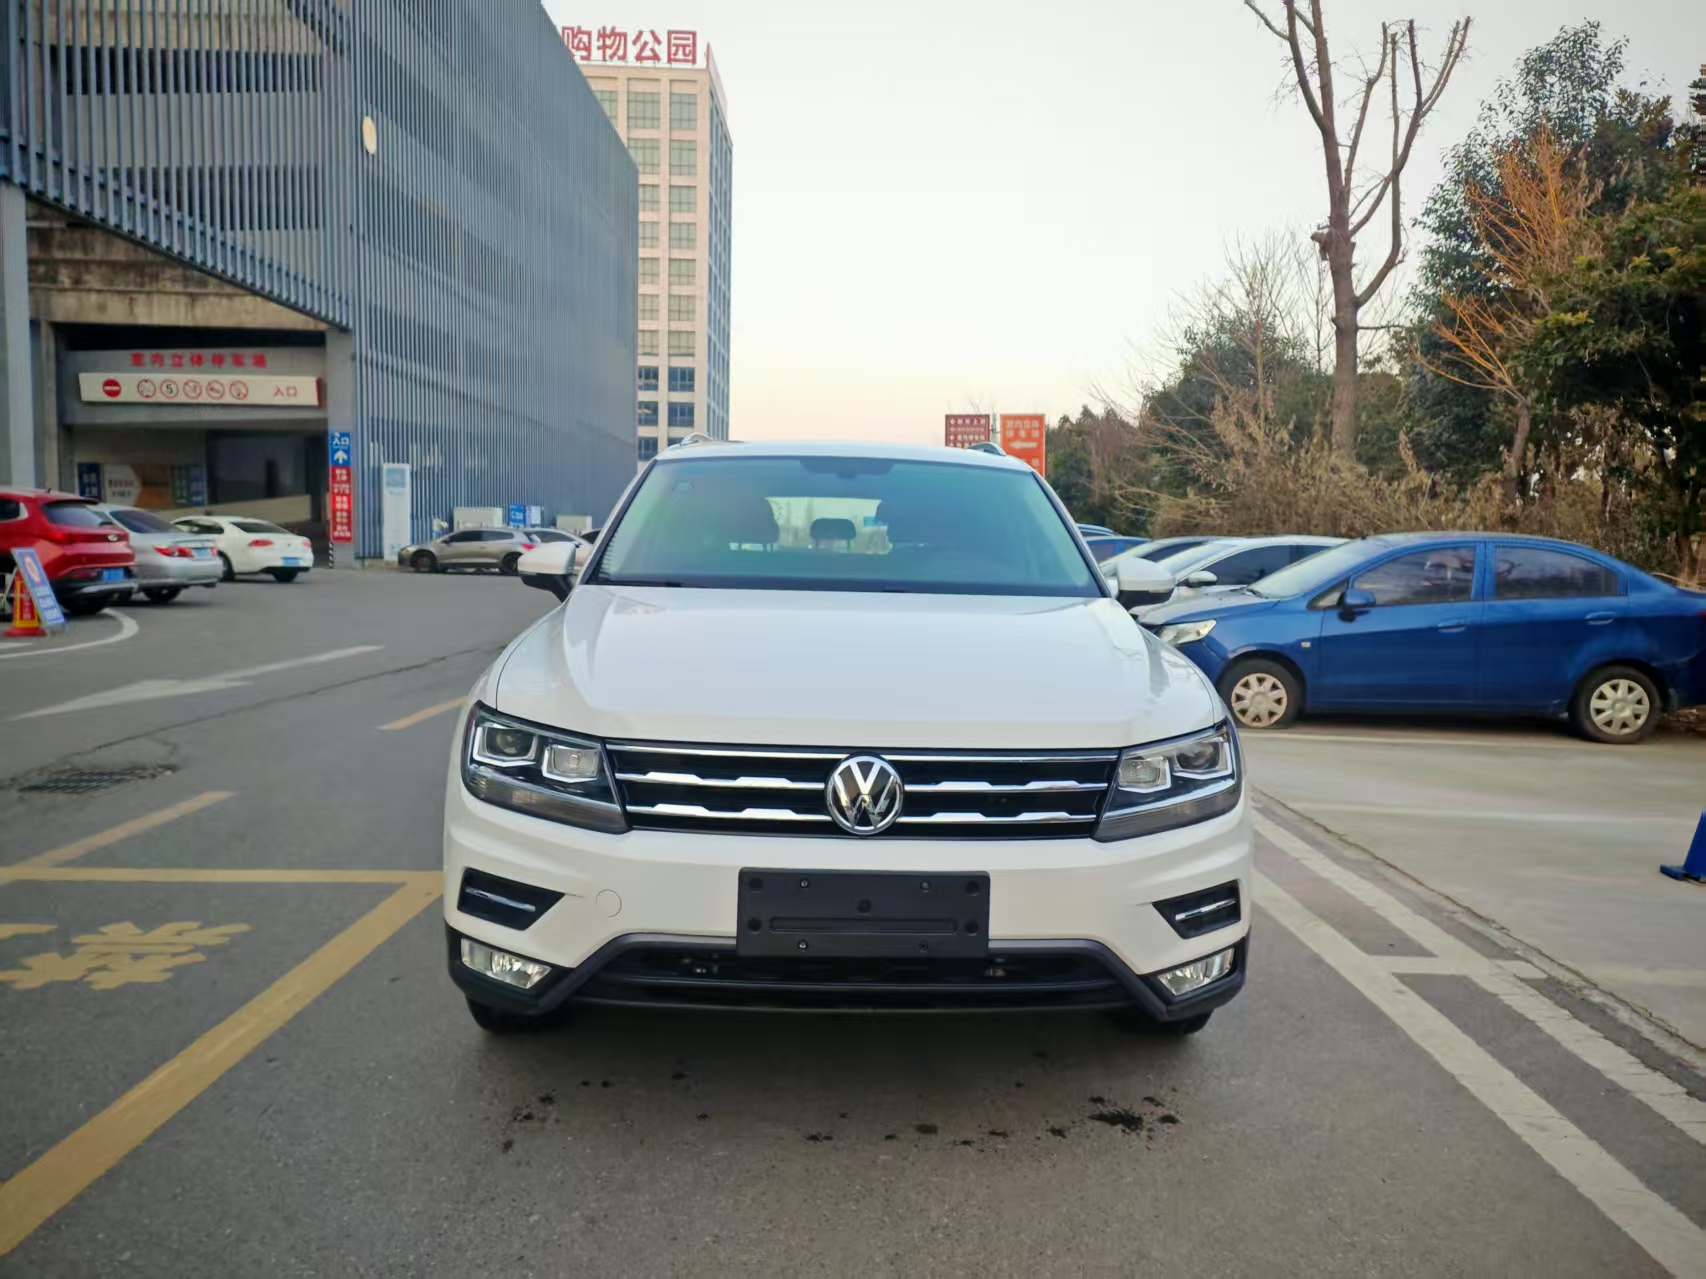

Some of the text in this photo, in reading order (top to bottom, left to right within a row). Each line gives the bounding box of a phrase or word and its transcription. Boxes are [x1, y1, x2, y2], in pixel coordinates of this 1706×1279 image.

[561, 25, 697, 64] 购物公园
[273, 387, 297, 398] 入口
[333, 432, 349, 445] 入口
